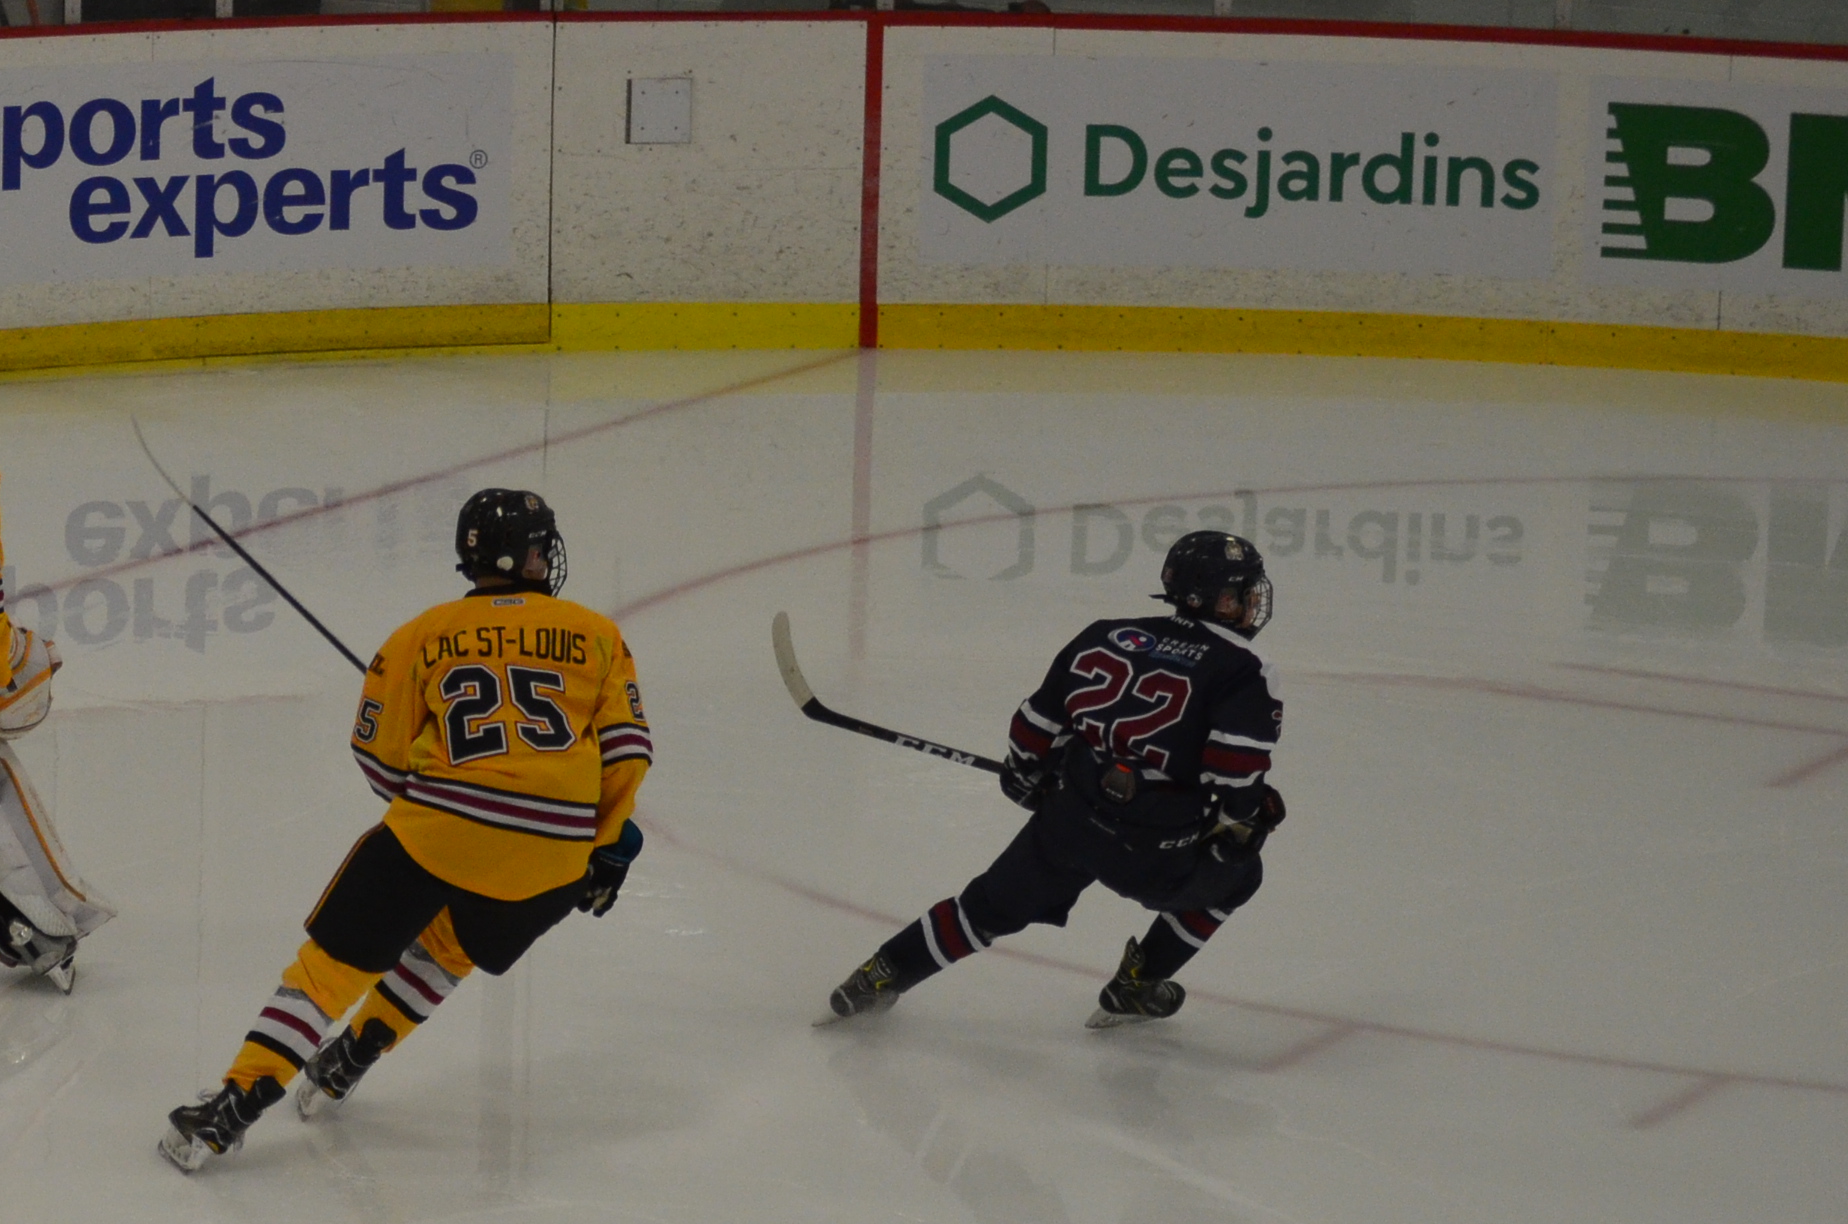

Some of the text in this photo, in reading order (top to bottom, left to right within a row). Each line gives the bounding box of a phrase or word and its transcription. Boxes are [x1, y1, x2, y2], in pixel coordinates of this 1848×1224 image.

[68, 148, 479, 258] experts
[1083, 127, 1541, 219] Desjardins
[422, 629, 467, 669] LAC
[476, 626, 587, 665] ST-LOUIS
[1155, 643, 1203, 661] SPORTS
[439, 662, 577, 766] 25
[895, 735, 976, 766] CCM
[1065, 646, 1193, 771] 22
